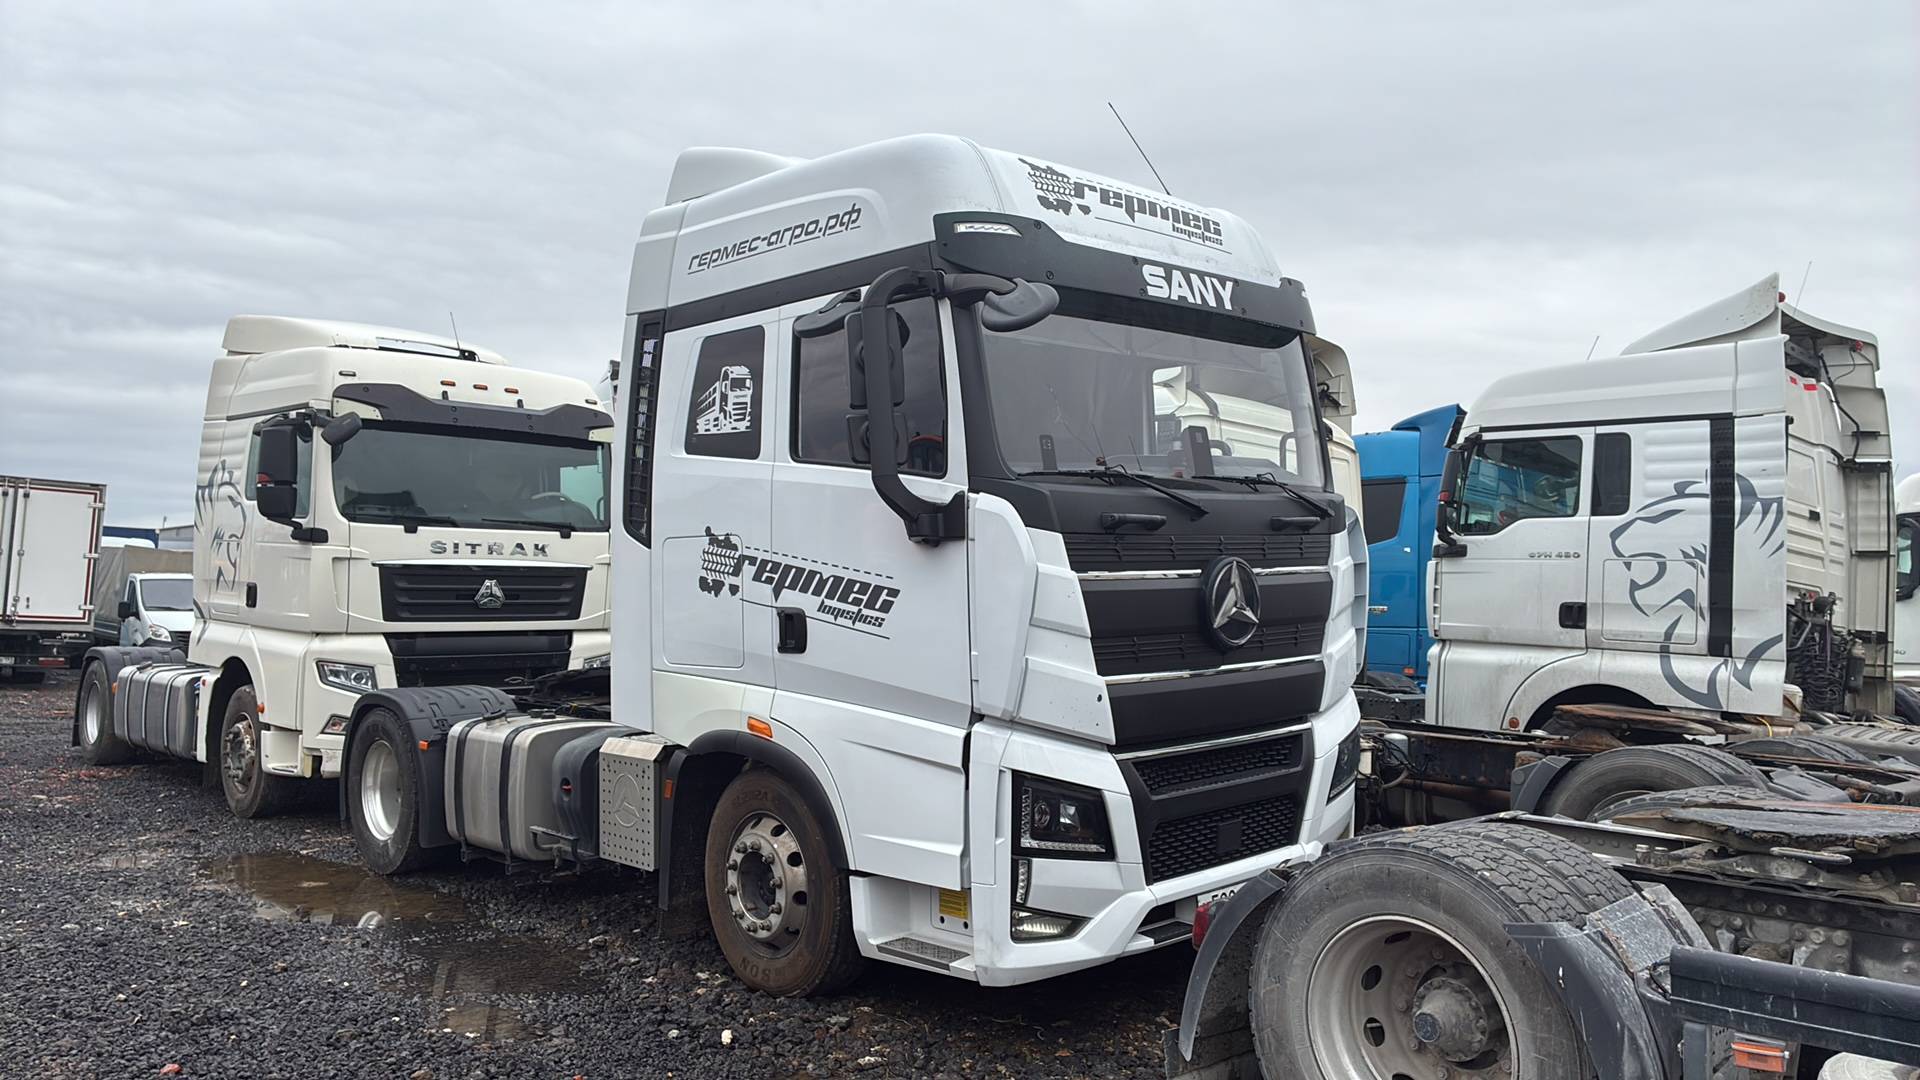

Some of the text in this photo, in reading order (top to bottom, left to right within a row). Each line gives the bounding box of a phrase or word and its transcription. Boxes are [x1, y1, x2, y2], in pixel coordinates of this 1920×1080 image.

[1172, 222, 1223, 246] logistics
[1142, 264, 1234, 311] SANY
[430, 541, 550, 558] SITRAK
[817, 599, 886, 628] logistics
